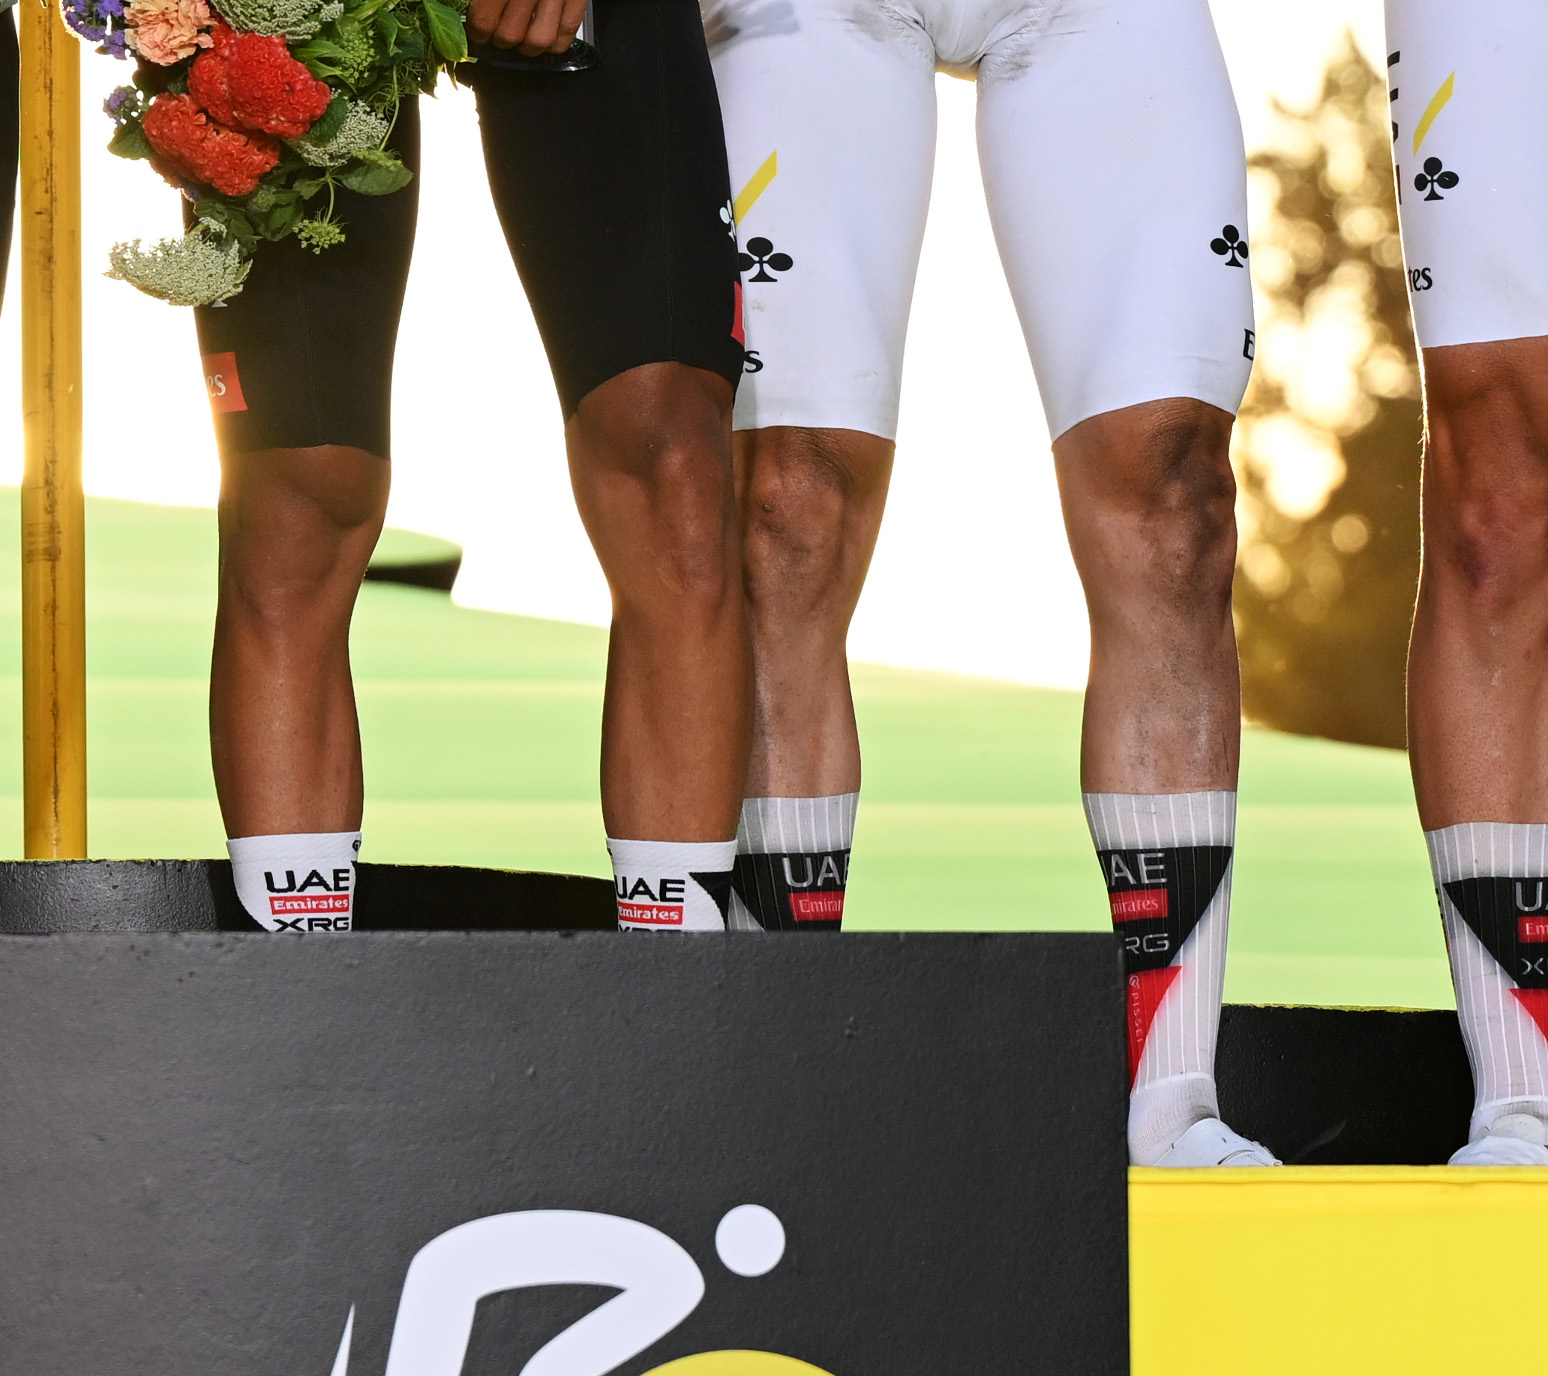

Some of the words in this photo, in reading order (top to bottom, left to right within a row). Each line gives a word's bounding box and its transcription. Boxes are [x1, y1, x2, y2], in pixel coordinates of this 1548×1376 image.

[265, 869, 350, 893] UAE
[273, 898, 349, 911] Emirates
[272, 917, 350, 932] XRG
